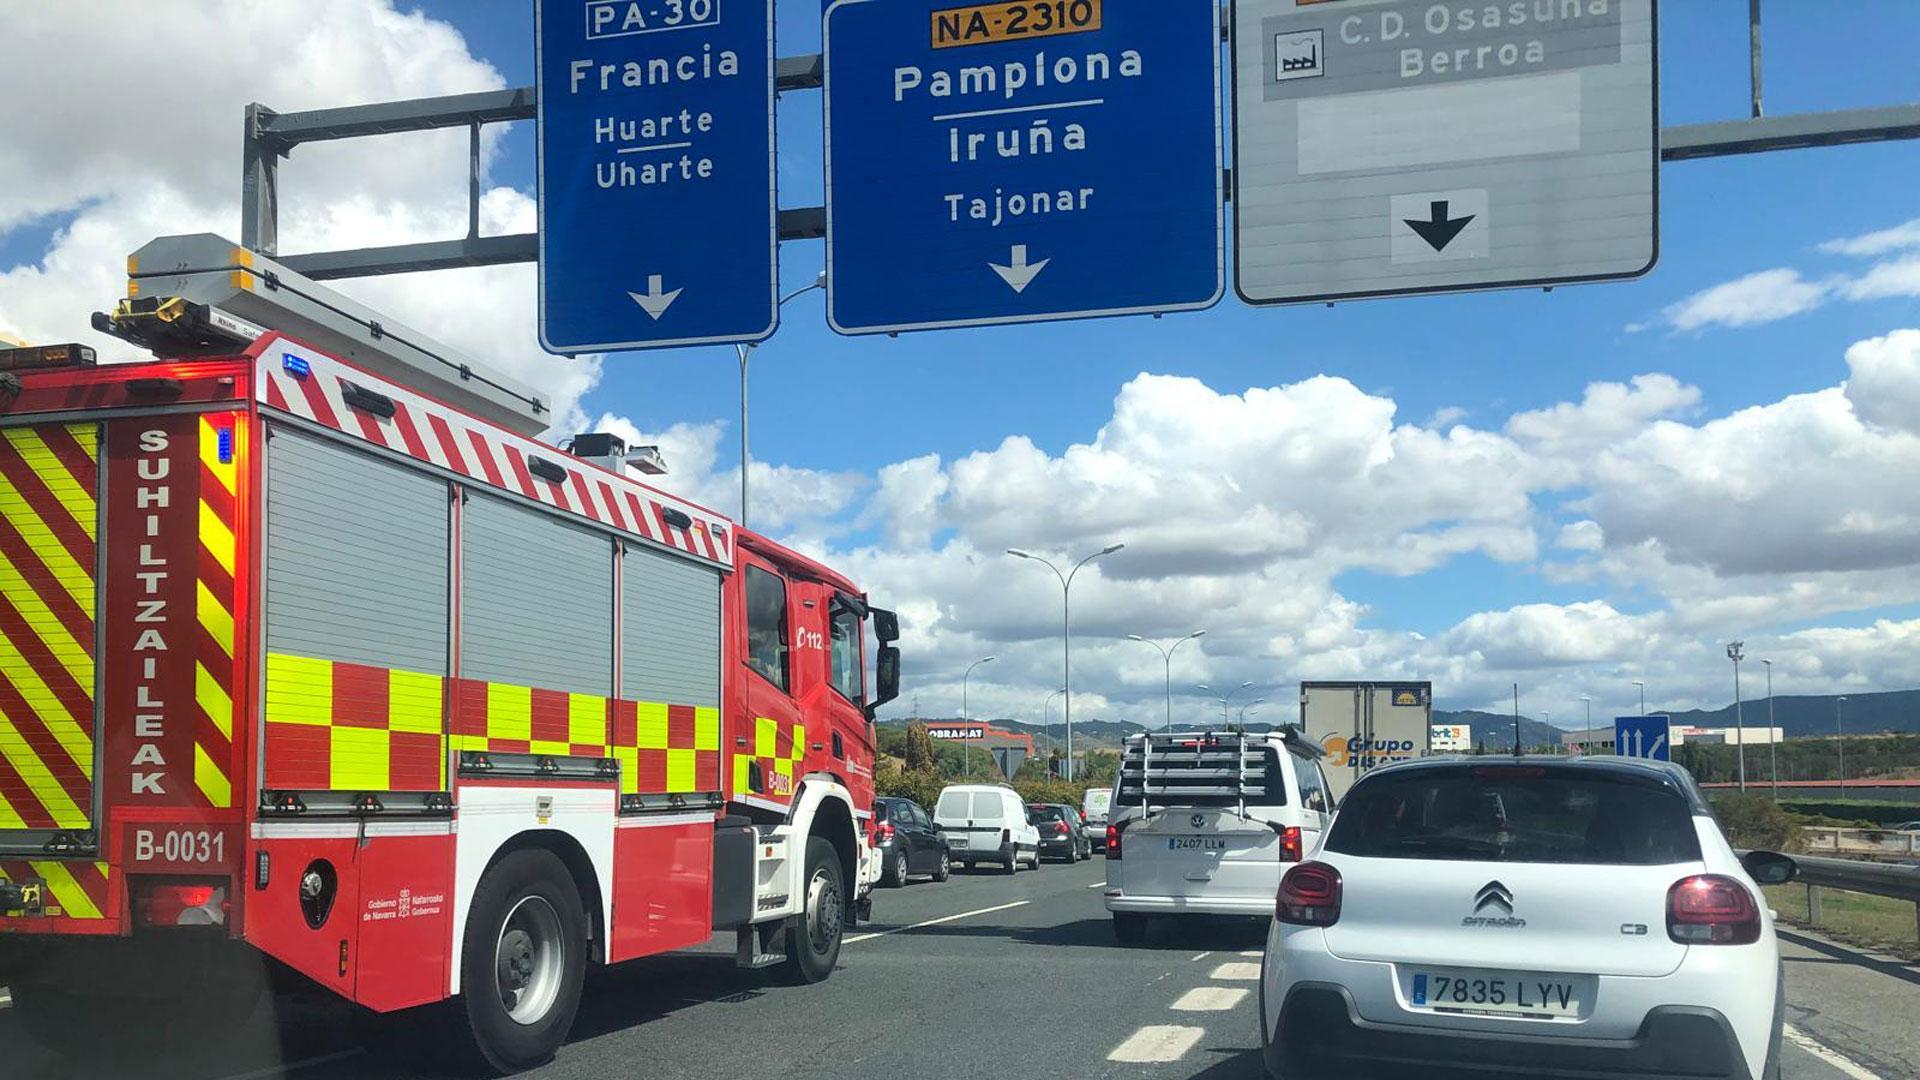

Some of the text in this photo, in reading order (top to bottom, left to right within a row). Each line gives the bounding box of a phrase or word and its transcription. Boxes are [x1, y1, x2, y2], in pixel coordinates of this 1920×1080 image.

[594, 0, 711, 33] PA-30
[937, 0, 1093, 43] NA-2310
[1425, 0, 1608, 34] Osasuna
[570, 43, 739, 94] Francia
[894, 49, 1143, 101] Pamplona
[1400, 40, 1544, 78] Berroa
[595, 109, 713, 143] Huarte
[949, 118, 1086, 162] Iruña
[596, 155, 713, 188] Uharte
[944, 187, 1094, 226] Tajonar
[131, 430, 170, 794] SUHILTZAILEAK
[806, 631, 822, 650] 112
[928, 729, 982, 738] OBRAMAT
[1347, 736, 1414, 755] Grupo
[136, 829, 224, 863] B-0031
[1176, 839, 1225, 849] 2407 LLM
[1620, 923, 1648, 935] C3
[1434, 976, 1572, 1010] 7835 LYV
